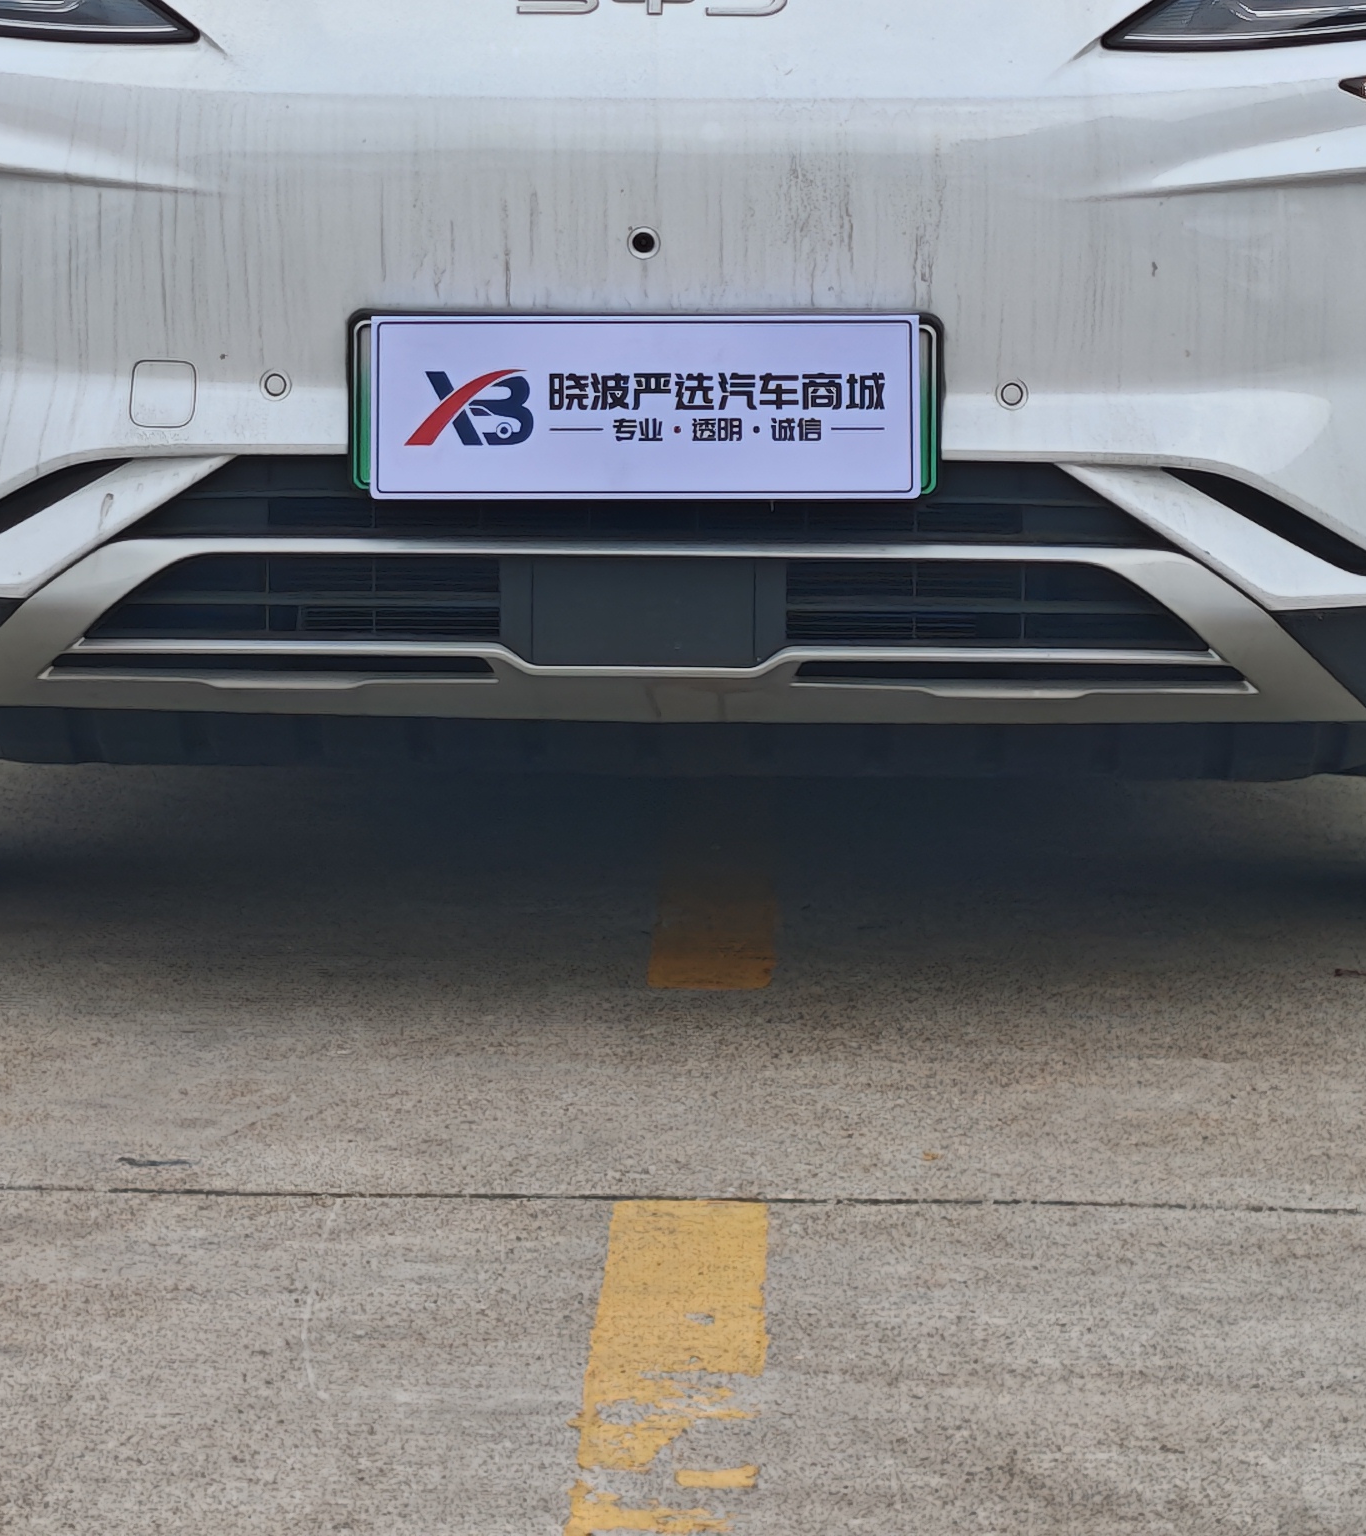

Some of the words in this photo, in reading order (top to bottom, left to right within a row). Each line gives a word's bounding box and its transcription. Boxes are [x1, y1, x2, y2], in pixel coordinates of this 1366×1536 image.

[548, 372, 886, 411] 晓波严选汽车商城
